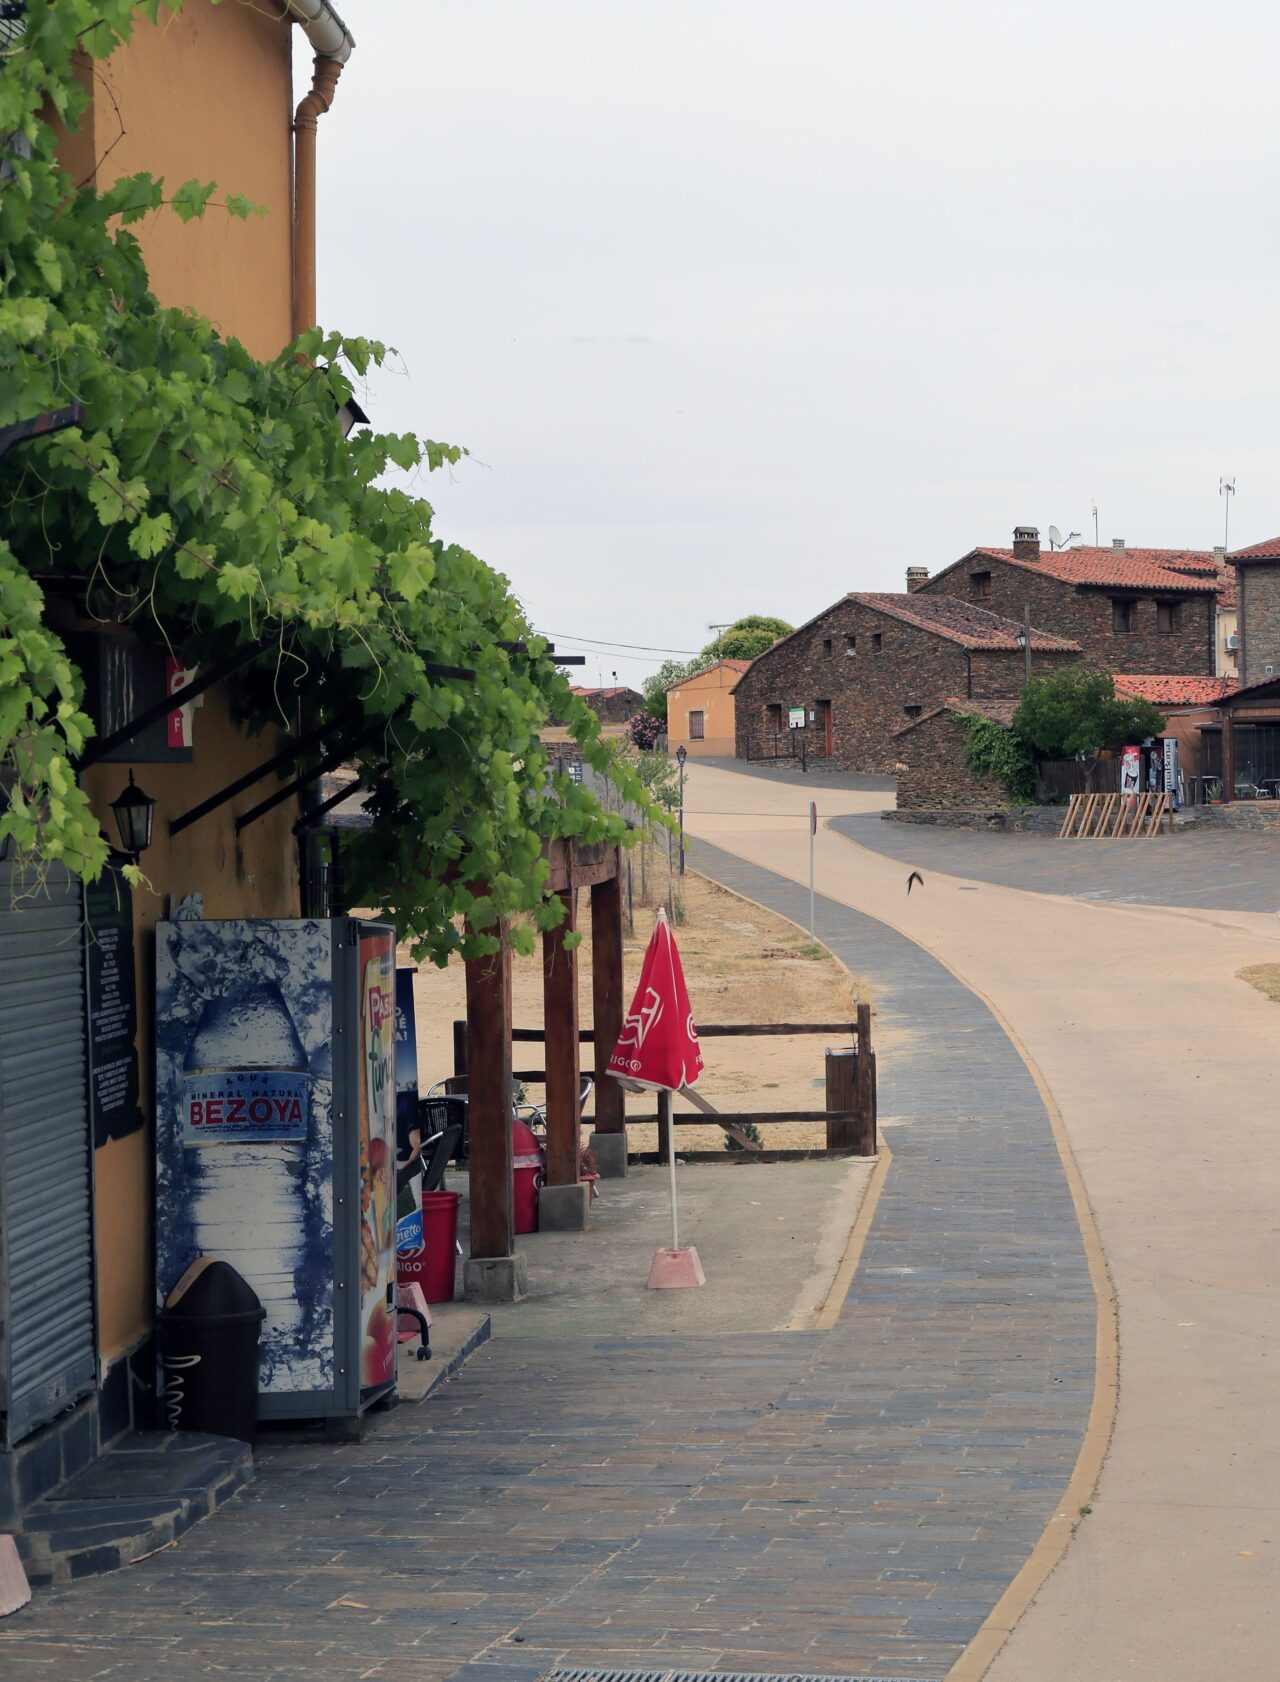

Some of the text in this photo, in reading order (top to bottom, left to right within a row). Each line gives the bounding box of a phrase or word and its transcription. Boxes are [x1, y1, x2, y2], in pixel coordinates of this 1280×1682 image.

[226, 1074, 268, 1085] AGUA
[191, 1089, 303, 1100] MINERAL NATURAL
[190, 1098, 303, 1125] BEZOYA
[396, 1224, 421, 1243] netto
[397, 1261, 422, 1272] RIGO
